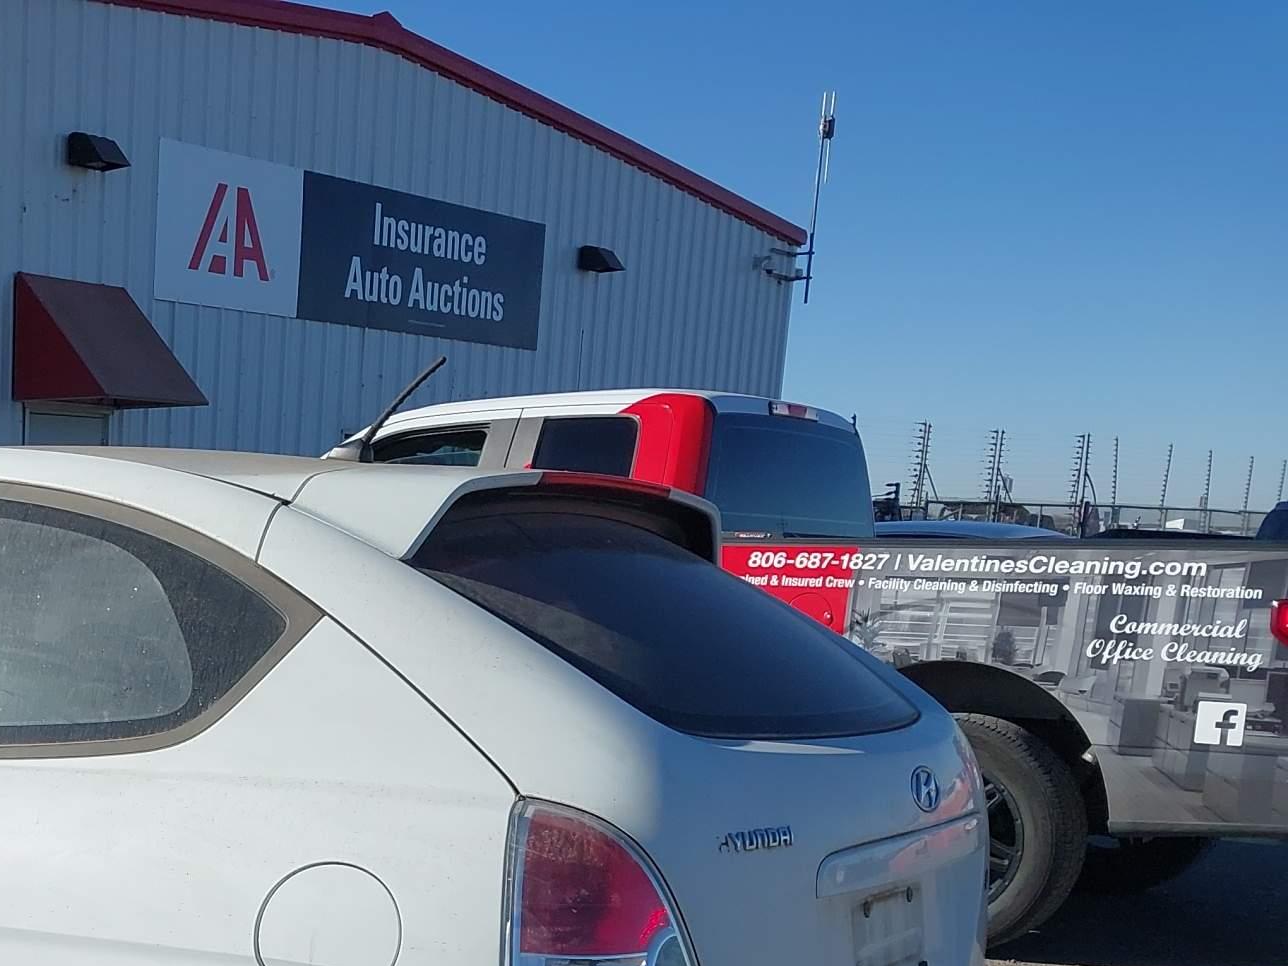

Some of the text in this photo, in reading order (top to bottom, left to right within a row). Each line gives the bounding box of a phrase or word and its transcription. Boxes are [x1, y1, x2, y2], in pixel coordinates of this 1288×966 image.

[372, 202, 487, 265] Insurance
[344, 256, 505, 322] Auto Auctions
[747, 551, 890, 571] 806-687-1827
[908, 553, 1207, 579] ValentinesCleaning.com
[770, 575, 779, 586] &
[782, 575, 823, 588] Insured
[826, 576, 855, 588] Crew
[868, 578, 911, 592] Facility
[913, 578, 966, 593] Cleaning
[969, 580, 979, 592] &
[982, 580, 1059, 596] Disinfecting
[1074, 582, 1109, 595] Floor
[1112, 583, 1162, 598] Waxing
[1165, 585, 1177, 597] &
[1180, 584, 1263, 600] Restoration
[1109, 614, 1248, 639] Commercial
[1086, 639, 1264, 673] Office Cleaning
